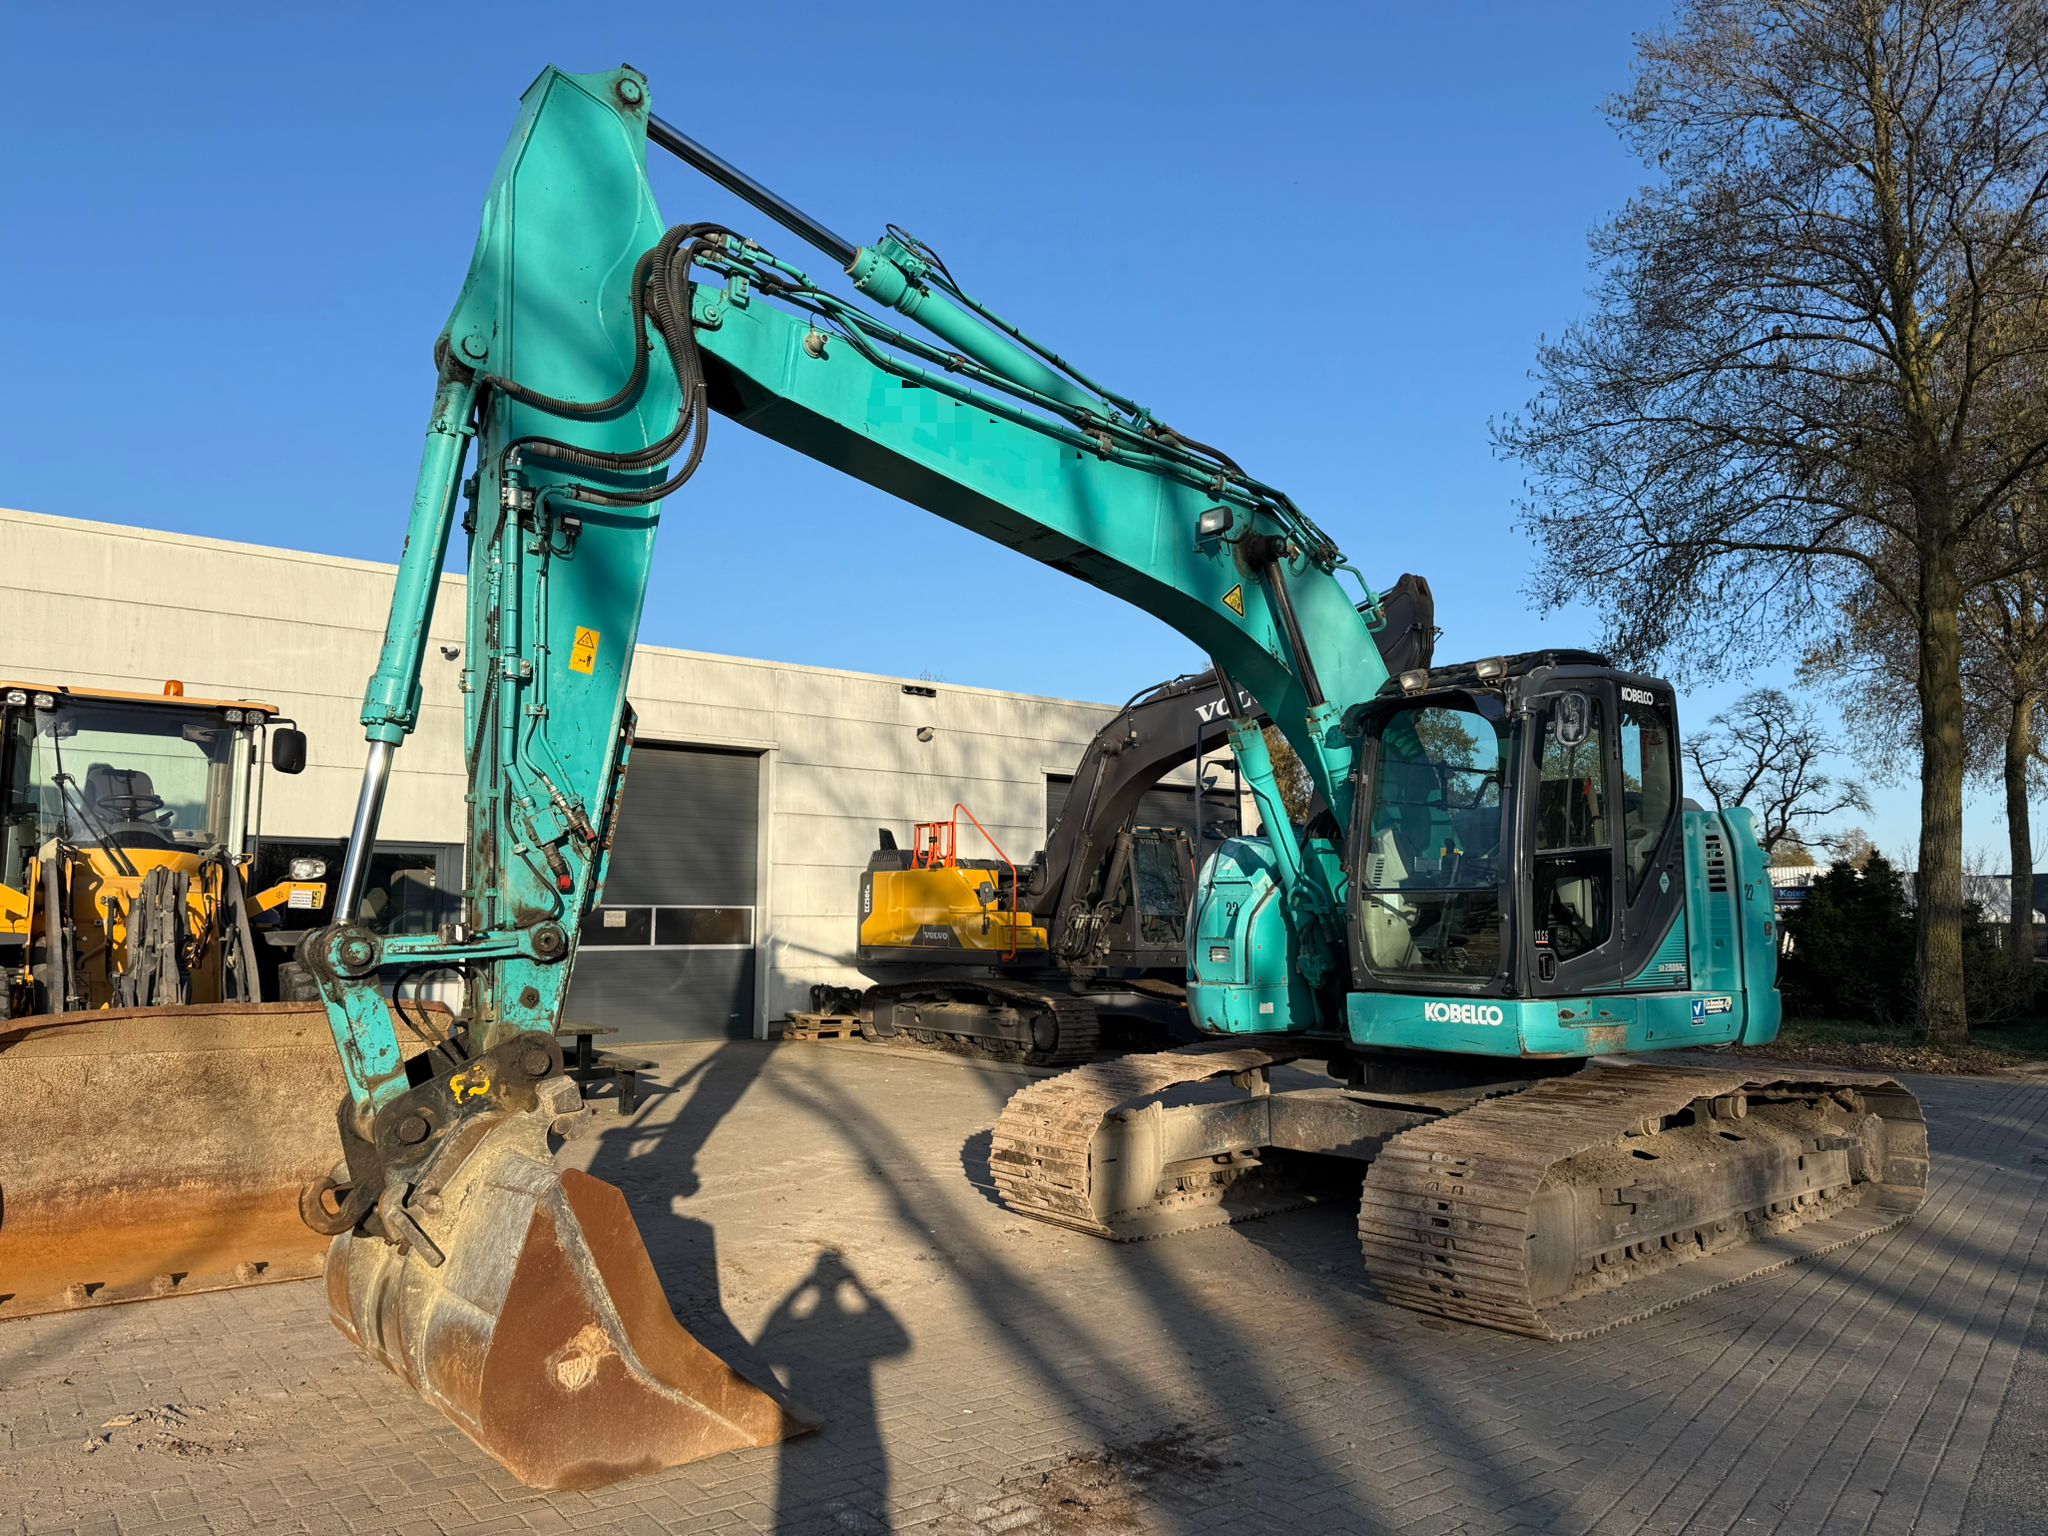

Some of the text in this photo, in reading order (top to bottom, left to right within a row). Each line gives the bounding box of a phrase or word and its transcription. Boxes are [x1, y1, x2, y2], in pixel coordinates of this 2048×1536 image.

[1621, 686, 1654, 706] KOBELCO
[1744, 883, 1754, 901] 22
[1226, 901, 1239, 917] 22
[924, 931, 948, 940] VOLVO
[1424, 1002, 1503, 1026] KOBELCO
